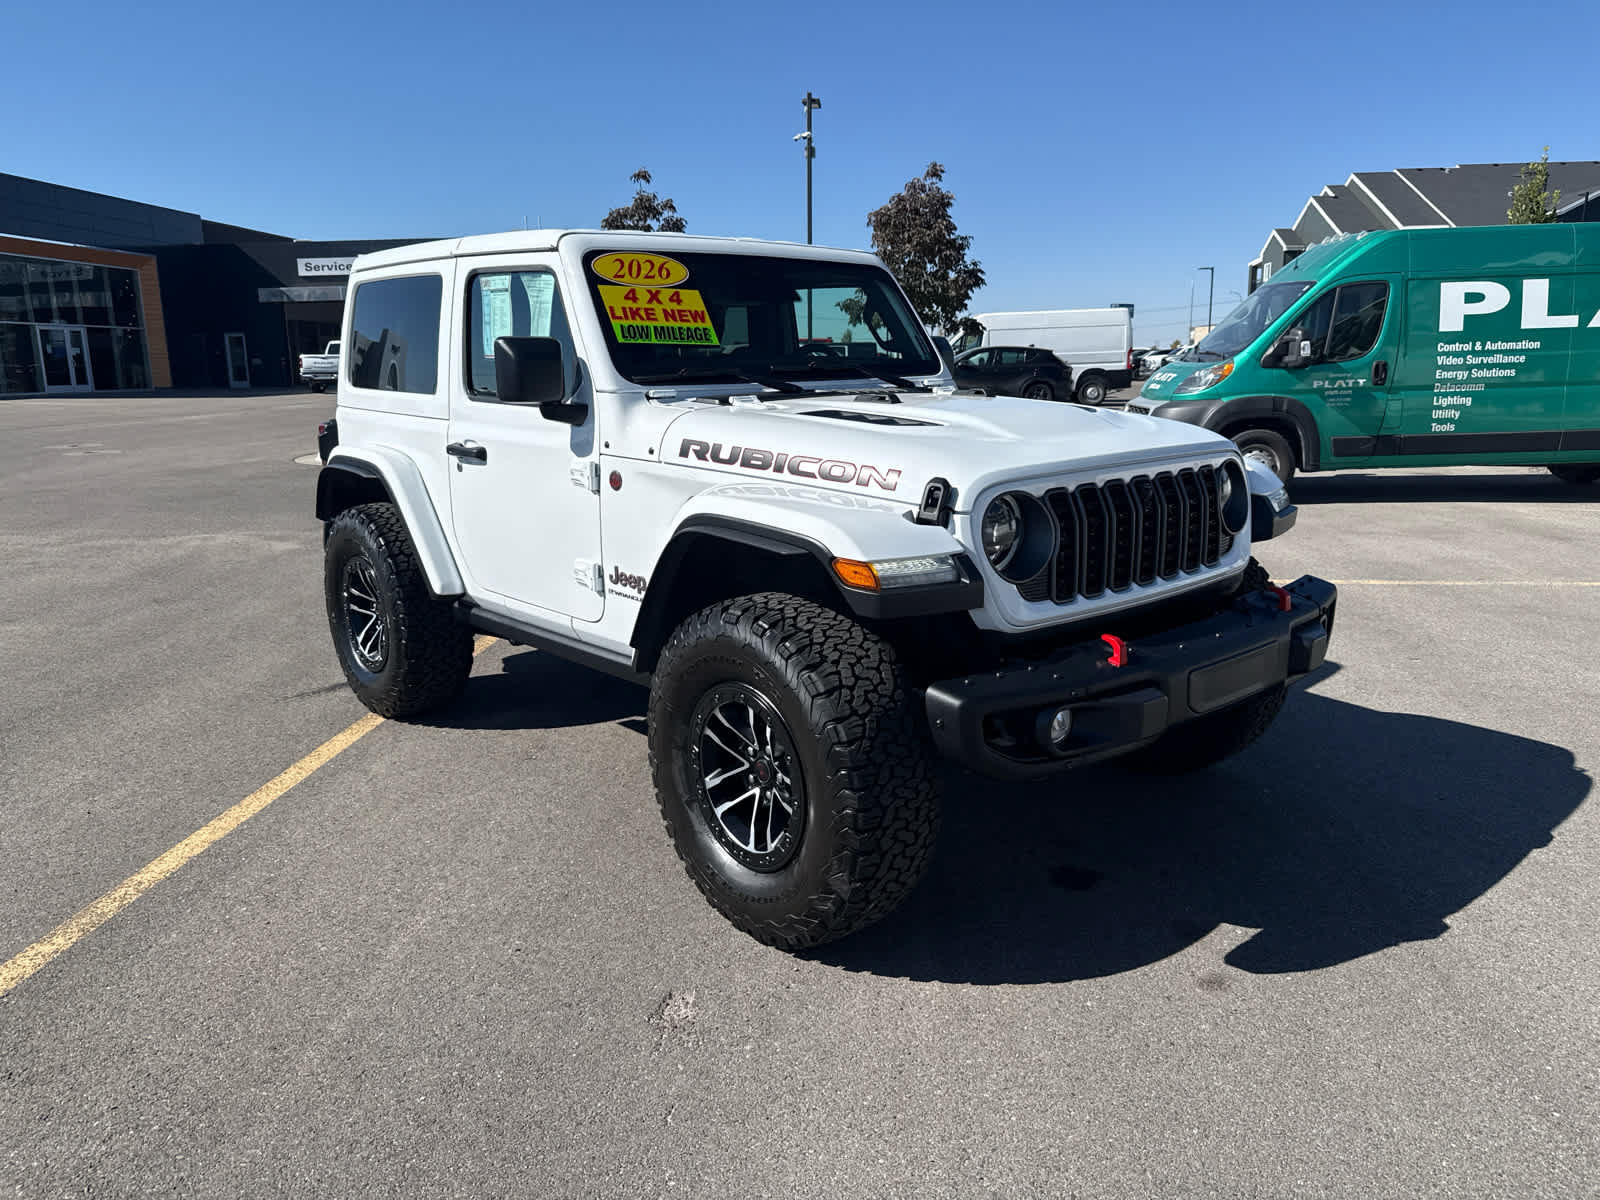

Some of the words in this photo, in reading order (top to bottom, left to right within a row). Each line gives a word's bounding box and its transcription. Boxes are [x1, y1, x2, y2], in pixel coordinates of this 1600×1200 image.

[304, 262, 352, 272] Service
[613, 258, 671, 280] 2026
[623, 288, 639, 305] 4
[668, 291, 683, 306] 4
[608, 306, 659, 322] LIKE
[662, 308, 706, 324] NEW
[620, 324, 652, 341] LOW
[653, 325, 713, 343] MILEAGE
[1437, 341, 1473, 352] Control
[1474, 341, 1483, 351] &
[1485, 340, 1541, 351] Automation
[1436, 355, 1464, 365] Video
[1466, 353, 1526, 365] Surveillance
[1435, 369, 1469, 380] Energy
[1471, 367, 1516, 378] Solutions
[1312, 378, 1367, 389] PLATT
[1433, 383, 1485, 392] Datacomm
[1433, 395, 1472, 406] Lighting
[1432, 409, 1461, 420] Utility
[1431, 423, 1455, 432] Tools
[678, 438, 902, 492] RUBICON
[609, 565, 647, 594] Jeep
